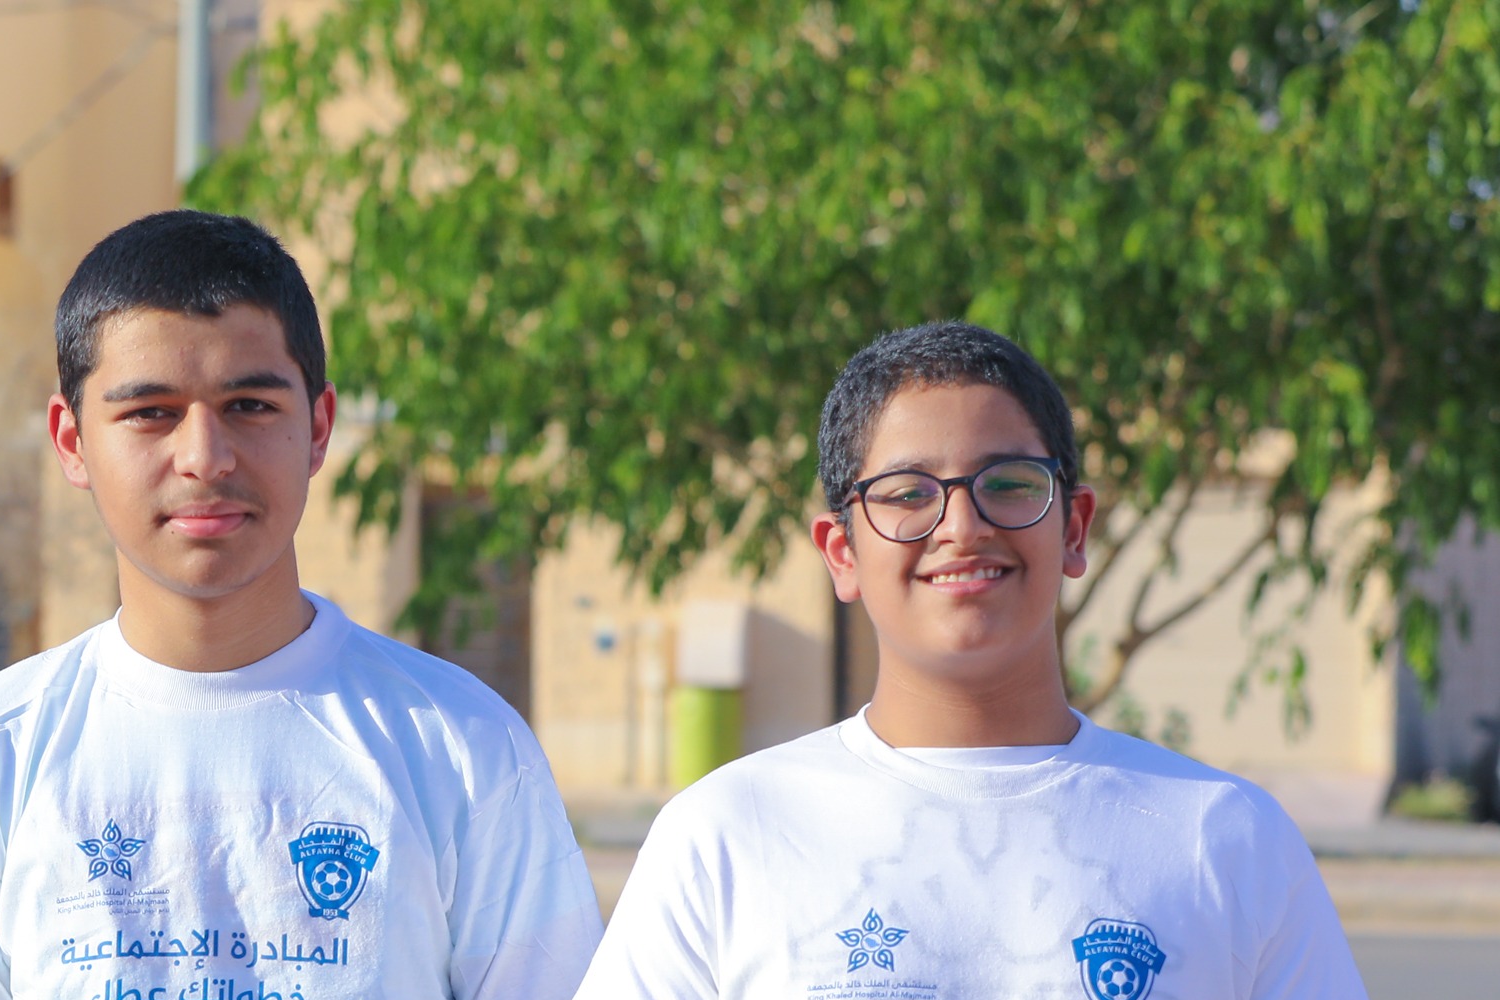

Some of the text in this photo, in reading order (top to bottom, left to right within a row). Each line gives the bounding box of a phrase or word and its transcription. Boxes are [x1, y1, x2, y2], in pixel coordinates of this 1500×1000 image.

[301, 848, 366, 864] ALFAYHA CLUB
[60, 930, 348, 971] المبادرة الإجتماعية
[1085, 946, 1154, 965] ALFAYHA CLUB
[855, 991, 888, 999] Hospital
